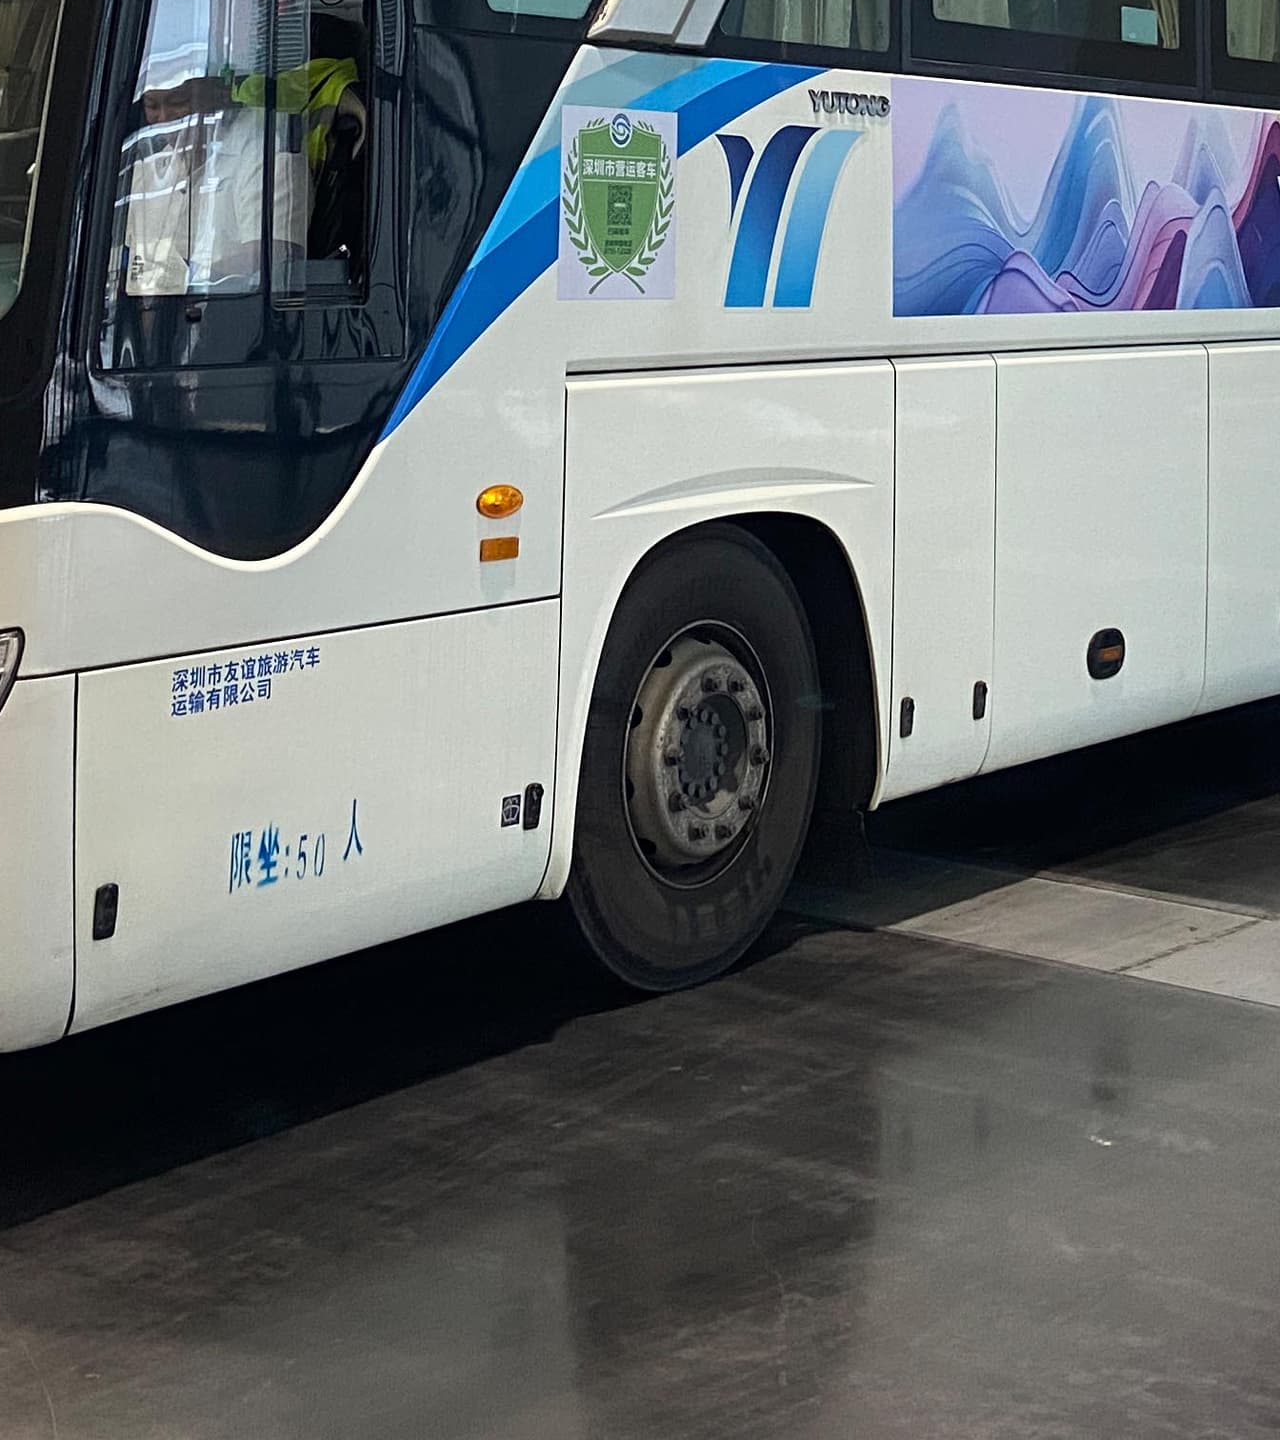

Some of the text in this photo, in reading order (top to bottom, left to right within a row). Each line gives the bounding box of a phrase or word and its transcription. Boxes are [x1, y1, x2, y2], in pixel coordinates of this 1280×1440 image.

[808, 89, 891, 117] YUTONG
[582, 157, 658, 180] 深圳市营运客车
[171, 646, 321, 693] 深圳市友谊旅游汽车
[170, 678, 273, 717] 运输有限公司
